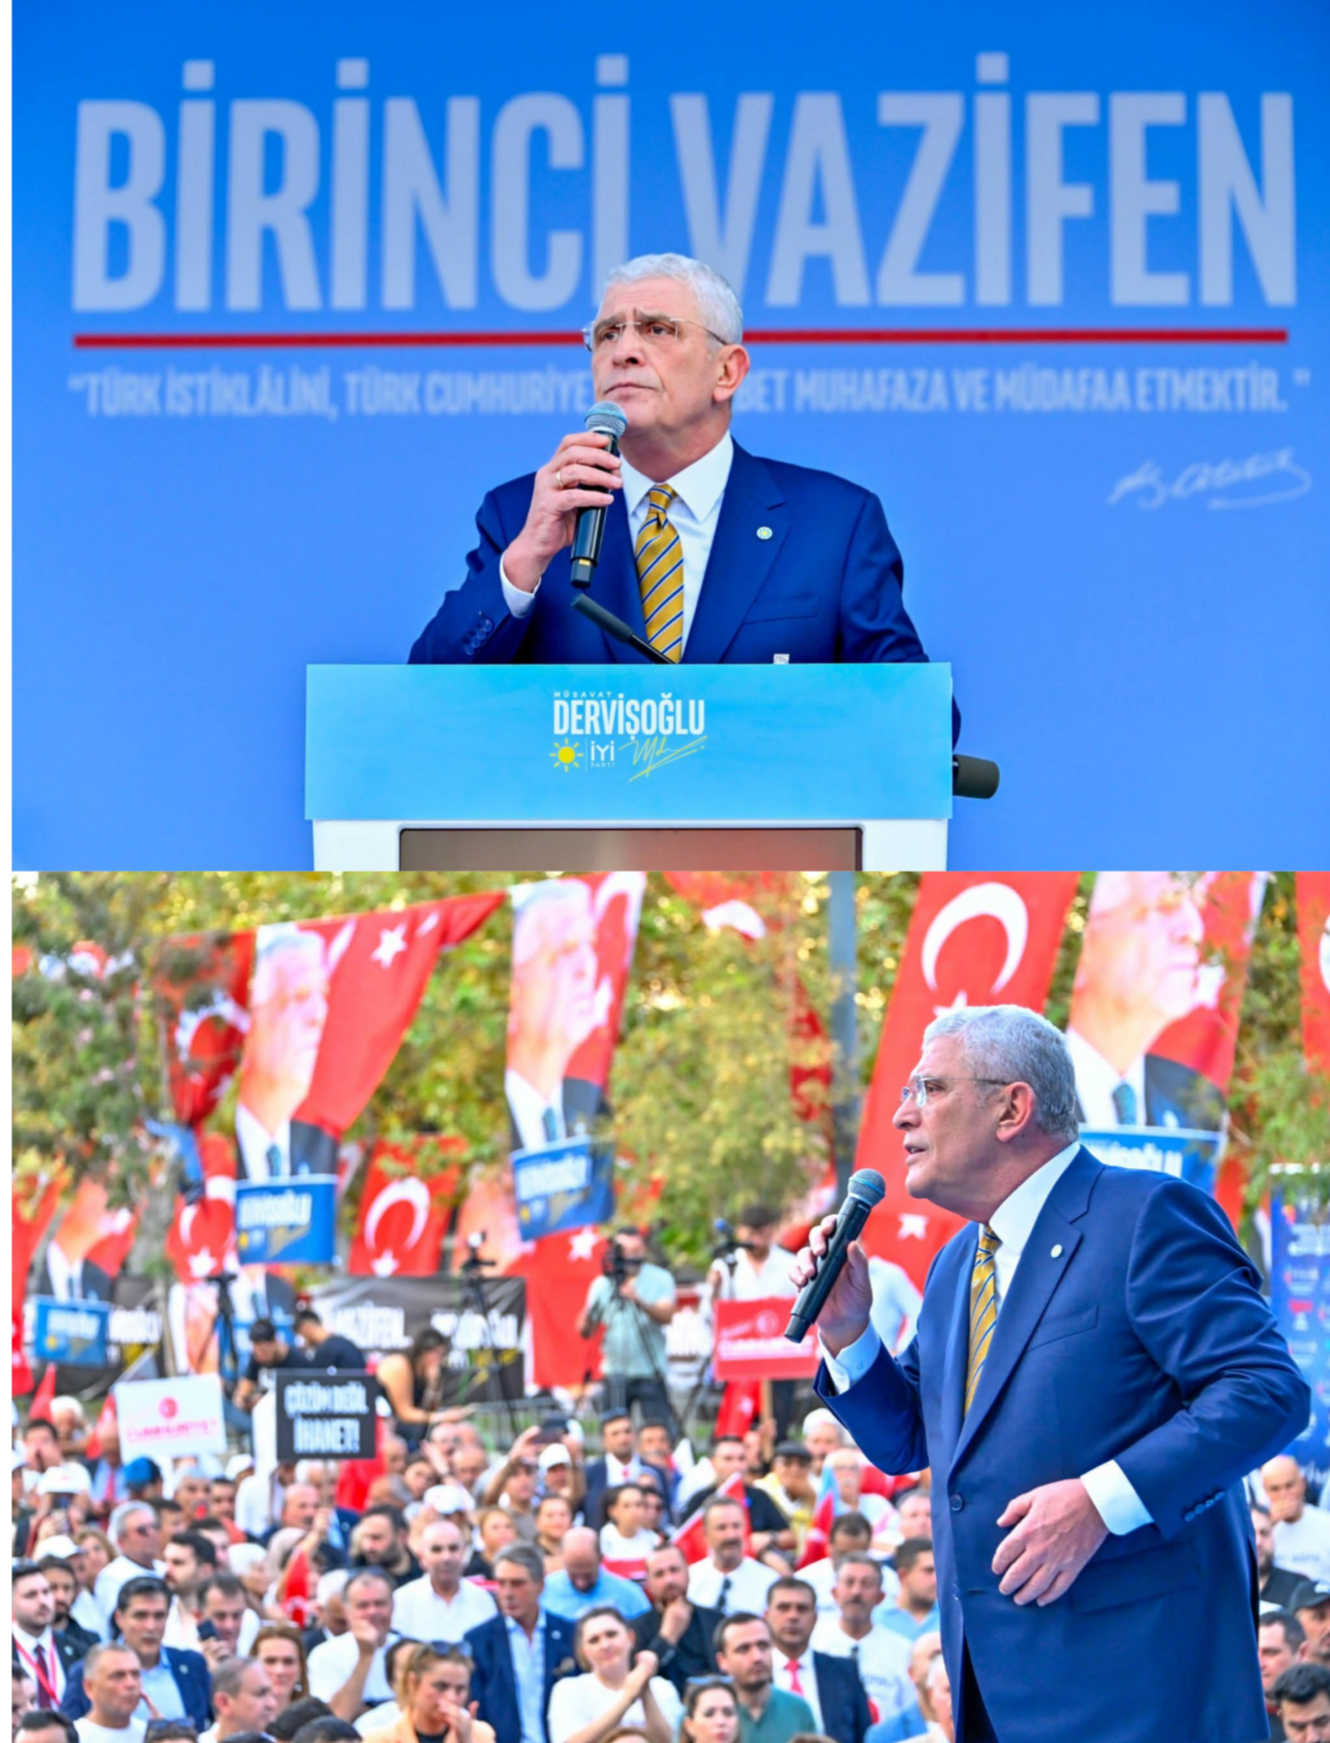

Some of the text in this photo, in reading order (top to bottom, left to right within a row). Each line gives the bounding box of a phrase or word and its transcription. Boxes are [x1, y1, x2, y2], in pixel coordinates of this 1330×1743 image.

[71, 51, 1296, 313] BİRİNCİ VAZİFEN
[344, 368, 422, 415] TÜRK
[426, 366, 595, 415] CUMHURİYE
[796, 368, 950, 413] MUHAFAZA
[953, 368, 990, 413] VE
[553, 692, 705, 741] DERVİŞOĞLU
[554, 690, 613, 698] MÜSAVAT
[590, 740, 615, 762] İYİ
